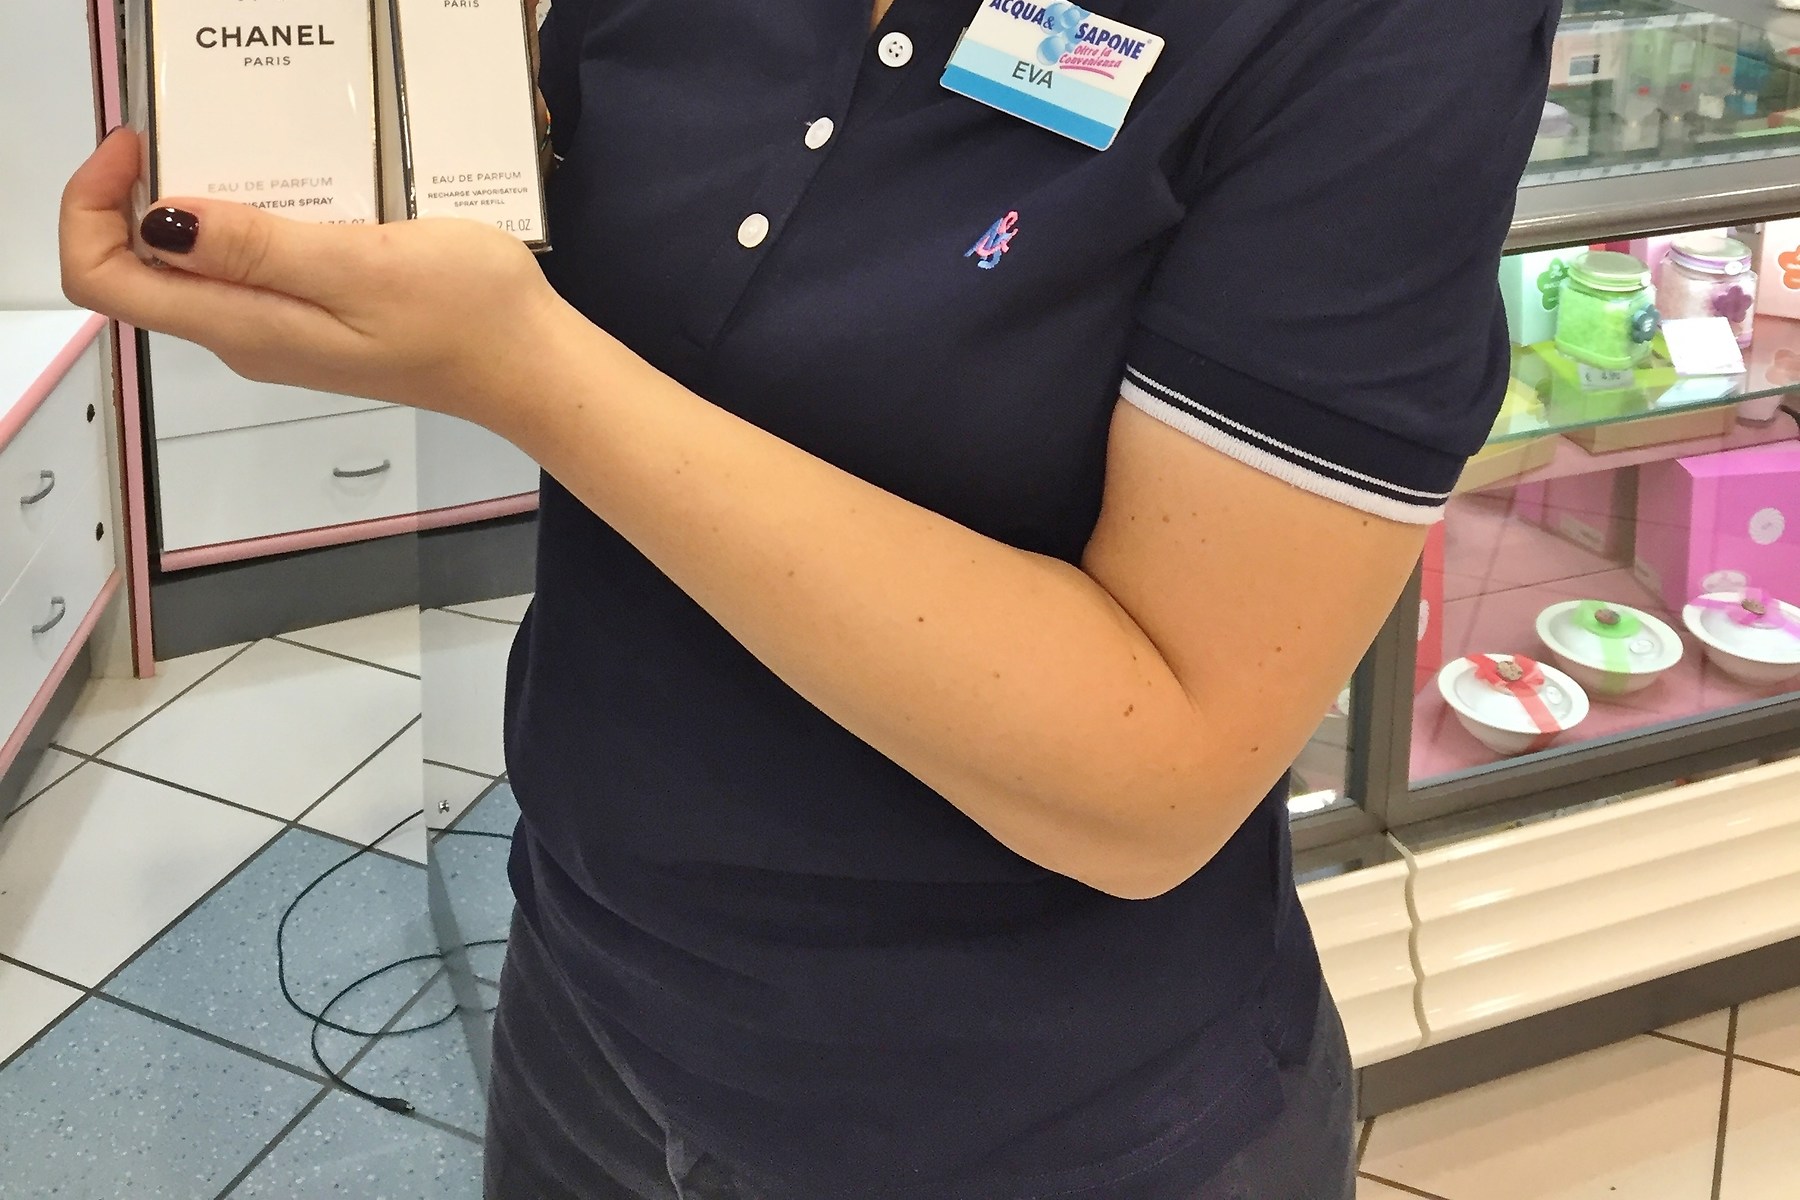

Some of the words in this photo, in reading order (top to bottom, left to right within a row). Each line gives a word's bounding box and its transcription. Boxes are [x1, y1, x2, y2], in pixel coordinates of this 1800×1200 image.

[443, 0, 480, 8] PARIS
[195, 24, 335, 49] CHANEL
[1075, 22, 1146, 60] SAPONE
[244, 56, 291, 67] PARIS
[1059, 54, 1122, 68] Convenienza
[1012, 60, 1054, 89] EVA
[432, 175, 455, 184] EAU
[459, 174, 473, 182] DE
[477, 171, 521, 181] PARFUM
[207, 183, 239, 193] EAU
[245, 180, 264, 191] DE
[270, 177, 333, 189] PARFUM
[428, 190, 470, 198] RECHARGE
[472, 187, 528, 196] VAPORISATEUR
[299, 197, 333, 206] SPRAY
[506, 219, 516, 231] FL
